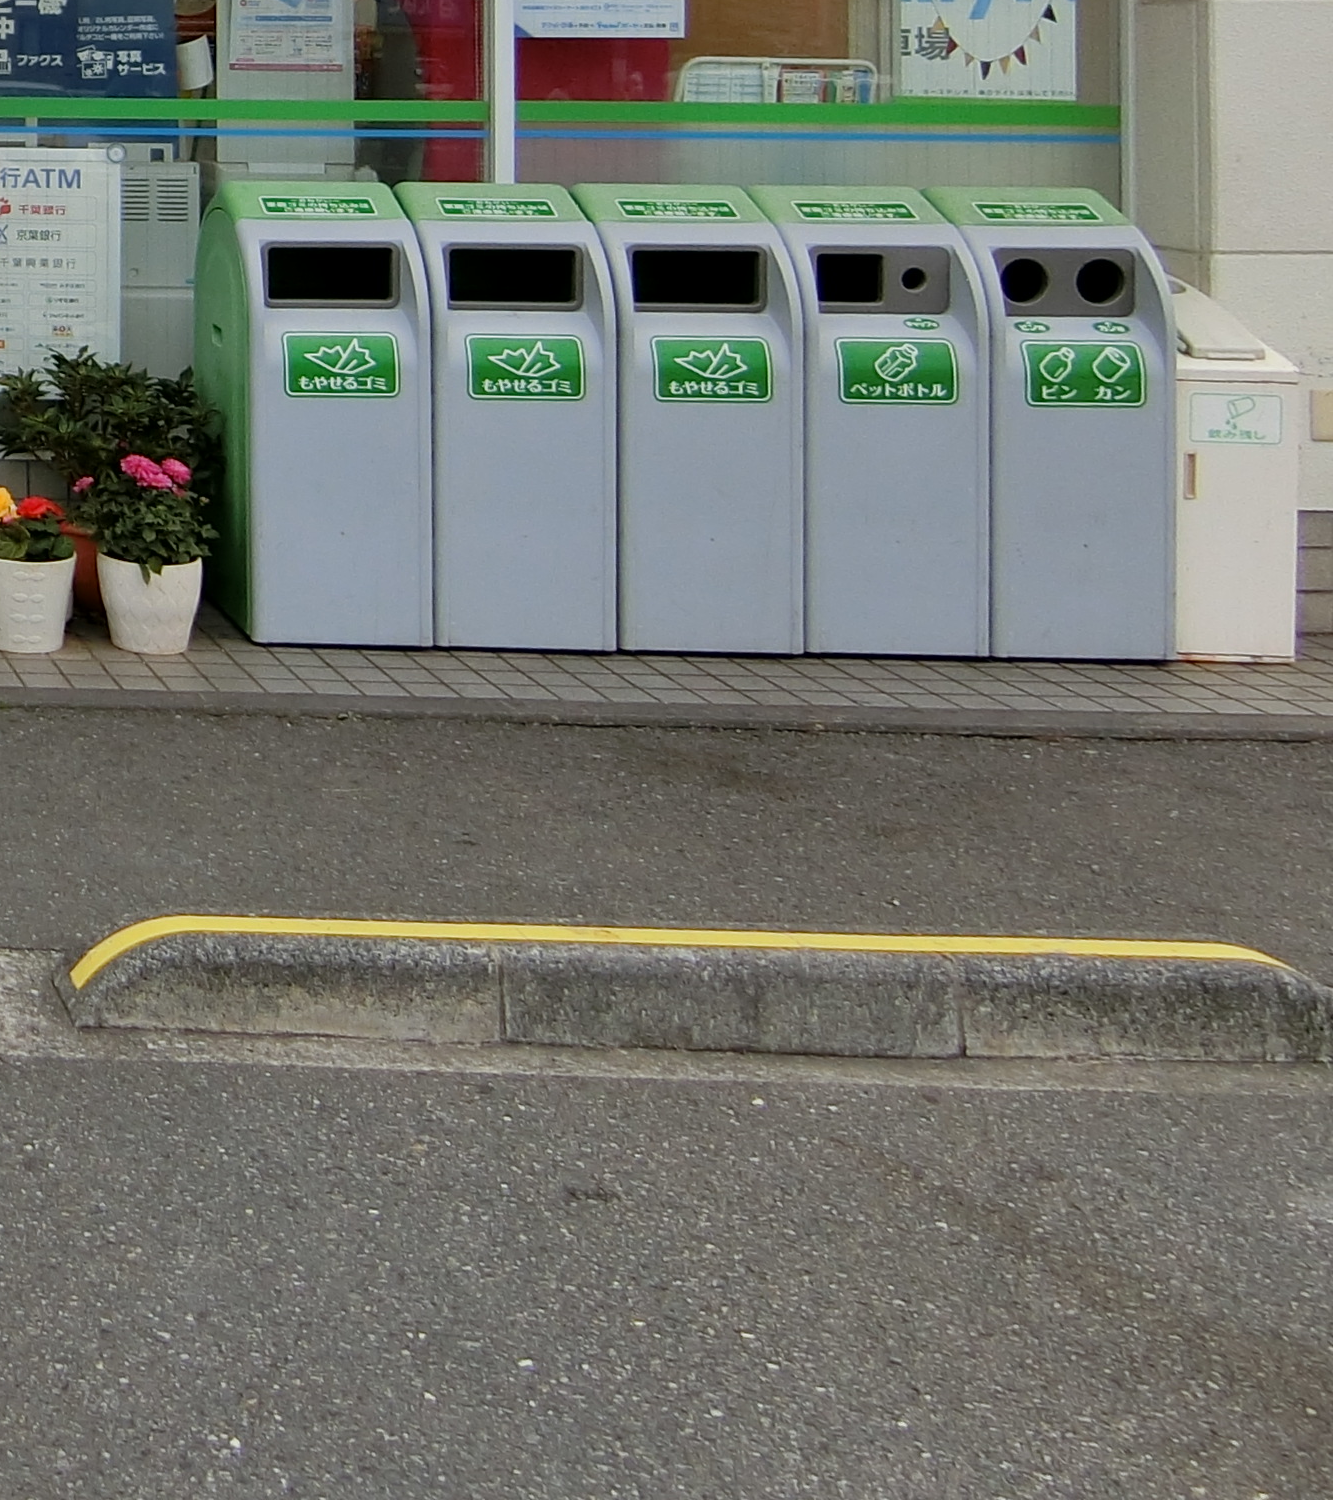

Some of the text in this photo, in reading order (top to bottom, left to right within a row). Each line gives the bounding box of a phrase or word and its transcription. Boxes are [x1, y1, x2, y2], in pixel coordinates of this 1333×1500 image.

[16, 54, 64, 67] ファクス
[117, 63, 167, 76] サービス
[16, 230, 61, 241] 京葉銀行
[298, 375, 387, 391] もやせるゴミ
[482, 378, 572, 394] もやせるゴミ
[668, 381, 760, 396] もやせるゴミ
[850, 383, 947, 398] ペットボトル
[1041, 383, 1078, 400] ビン
[1094, 384, 1131, 401] カン
